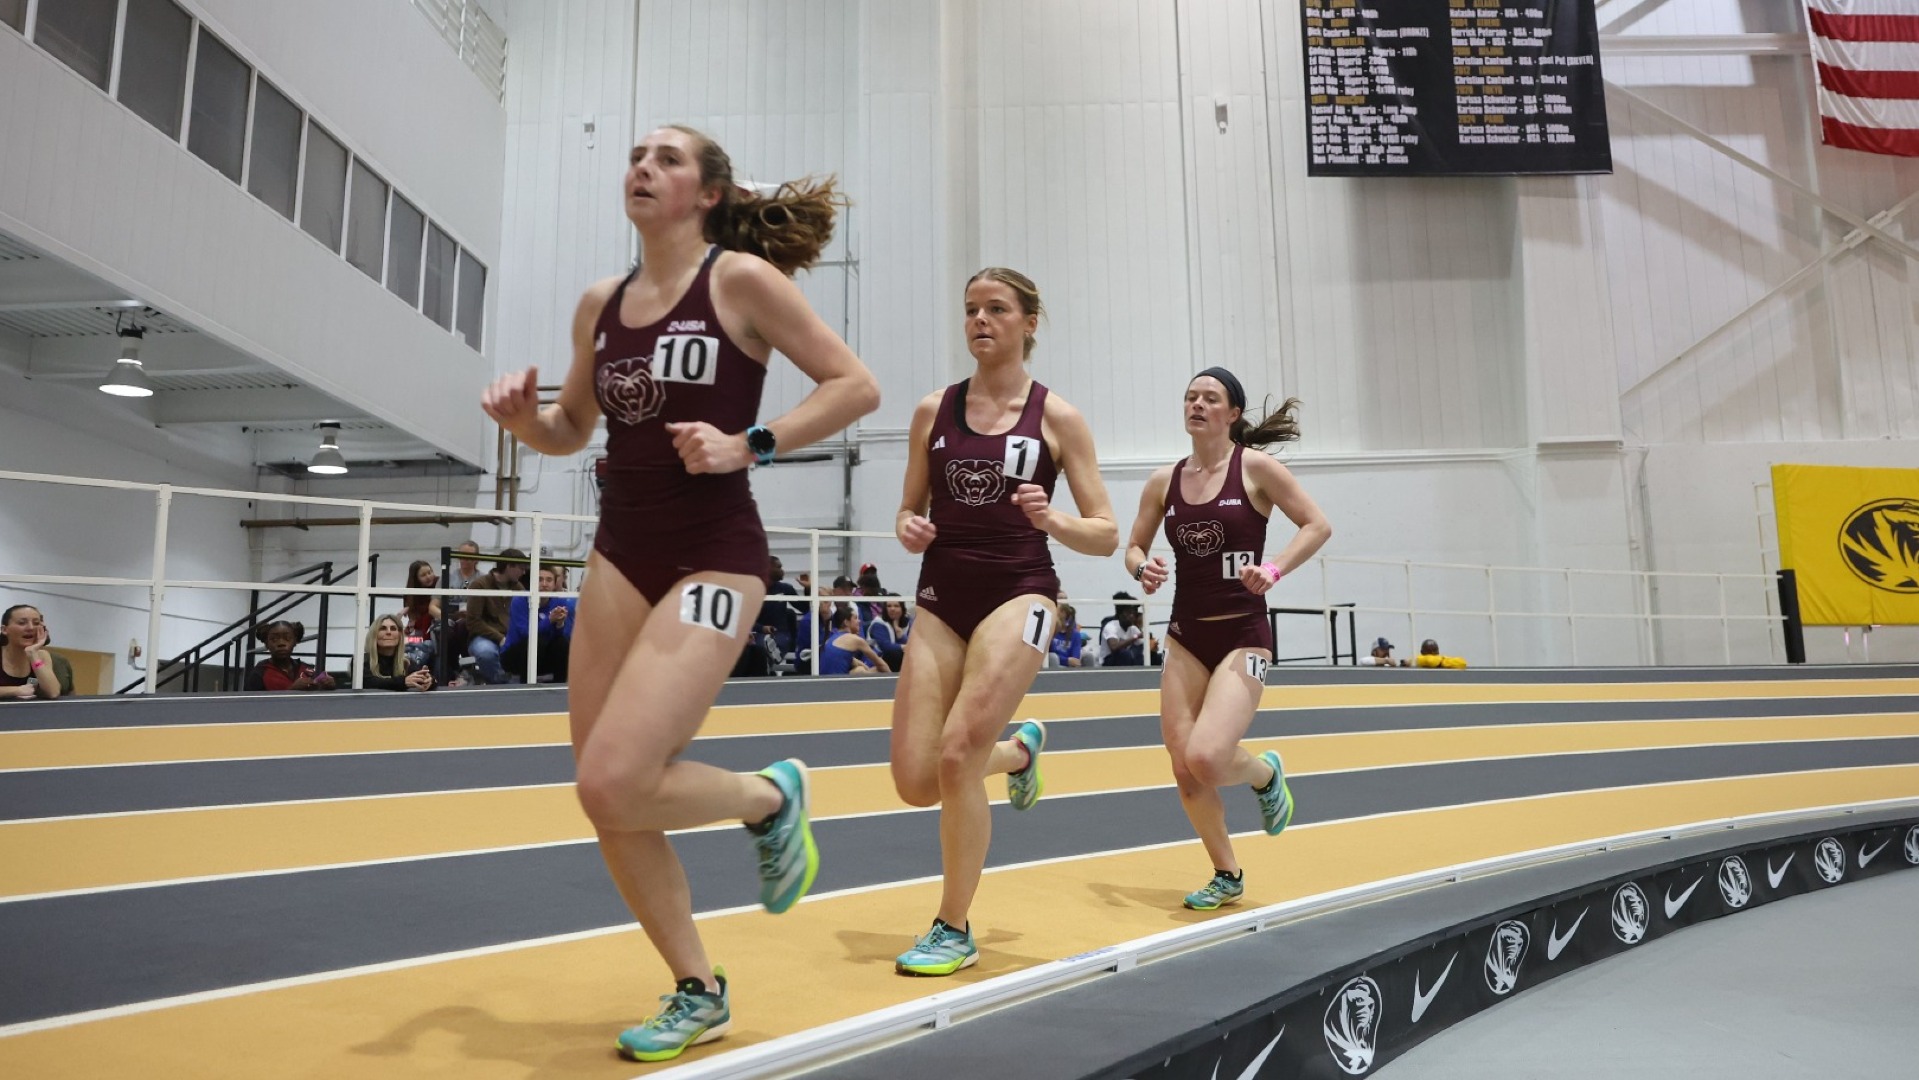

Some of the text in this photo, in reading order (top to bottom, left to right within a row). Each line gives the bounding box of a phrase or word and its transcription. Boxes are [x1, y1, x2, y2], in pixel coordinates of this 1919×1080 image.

[659, 337, 708, 381] 10
[1011, 439, 1028, 477] 1
[687, 584, 734, 631] 10
[1031, 608, 1045, 646] 1
[1248, 654, 1267, 682] 13
